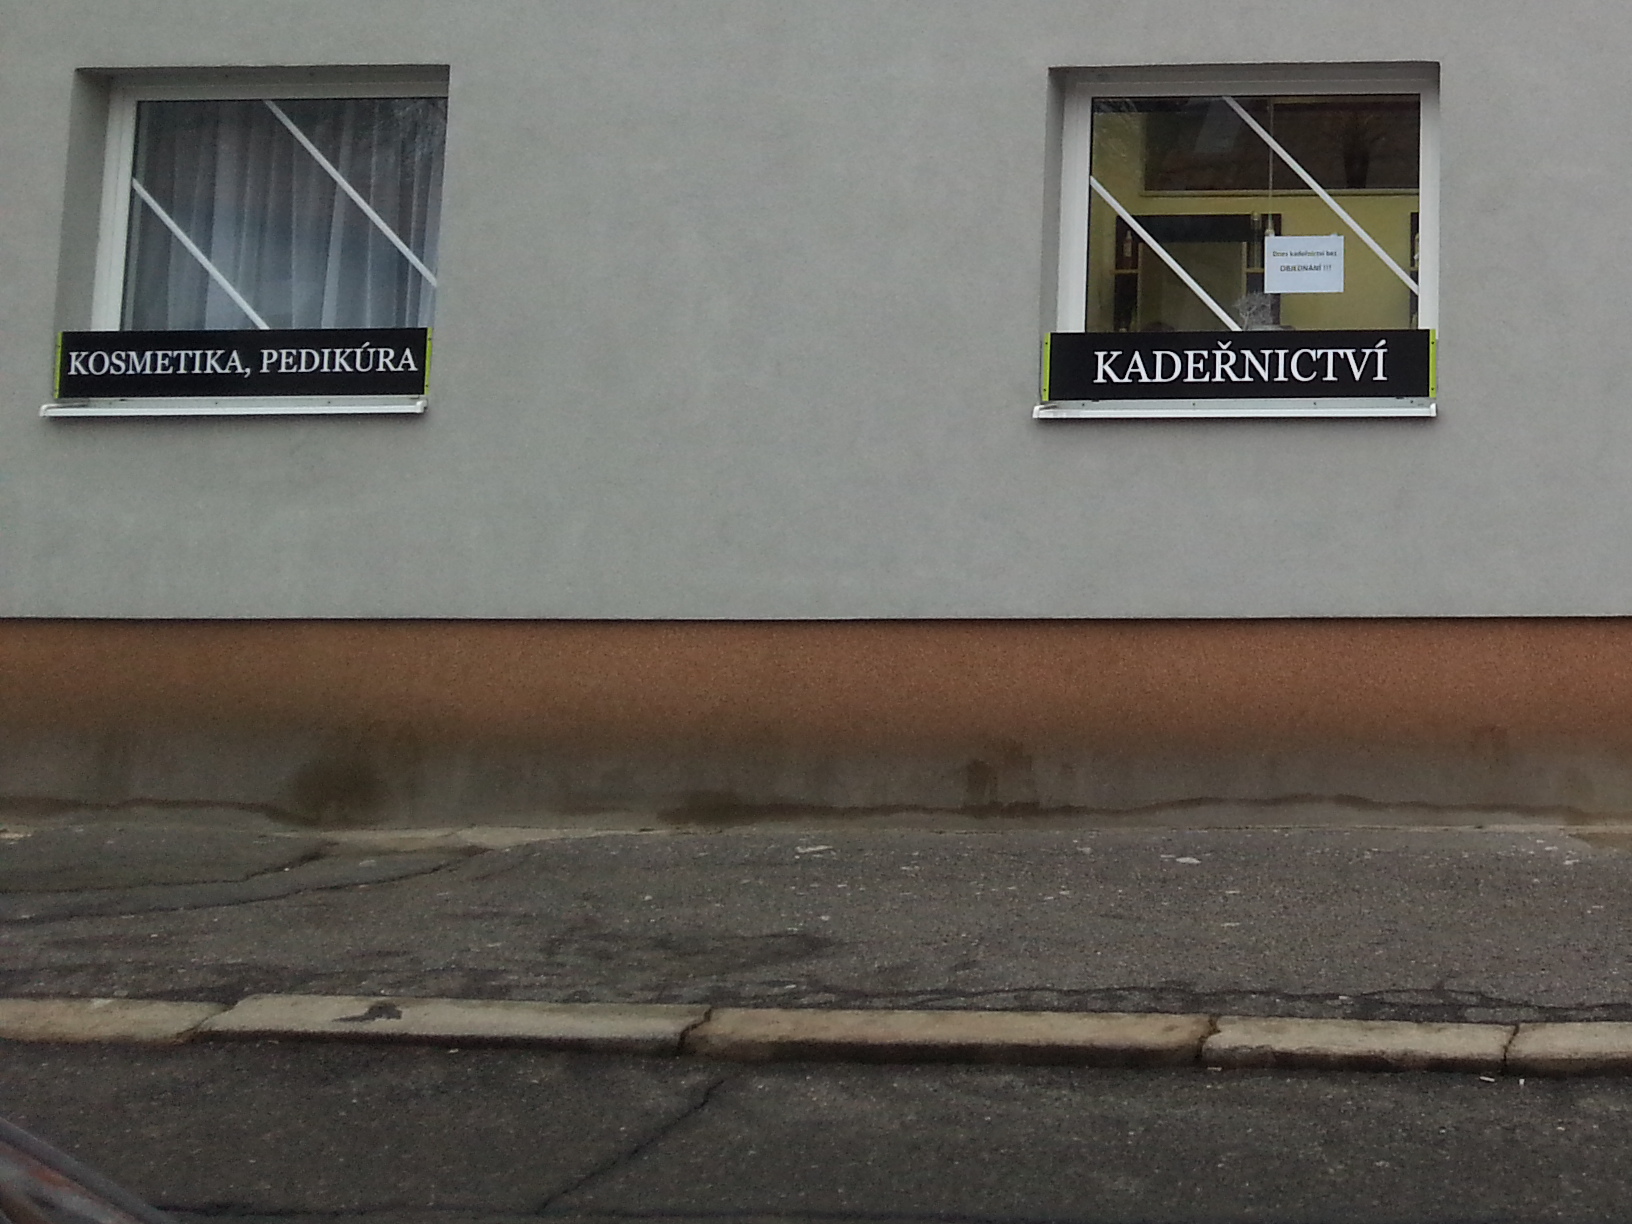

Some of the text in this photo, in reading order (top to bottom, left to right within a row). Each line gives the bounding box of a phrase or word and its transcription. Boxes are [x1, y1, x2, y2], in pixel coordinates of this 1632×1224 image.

[67, 342, 418, 378] KOSMETIKA, PEDIKÚRA
[1093, 339, 1388, 384] KADEŘNICTVÍ
